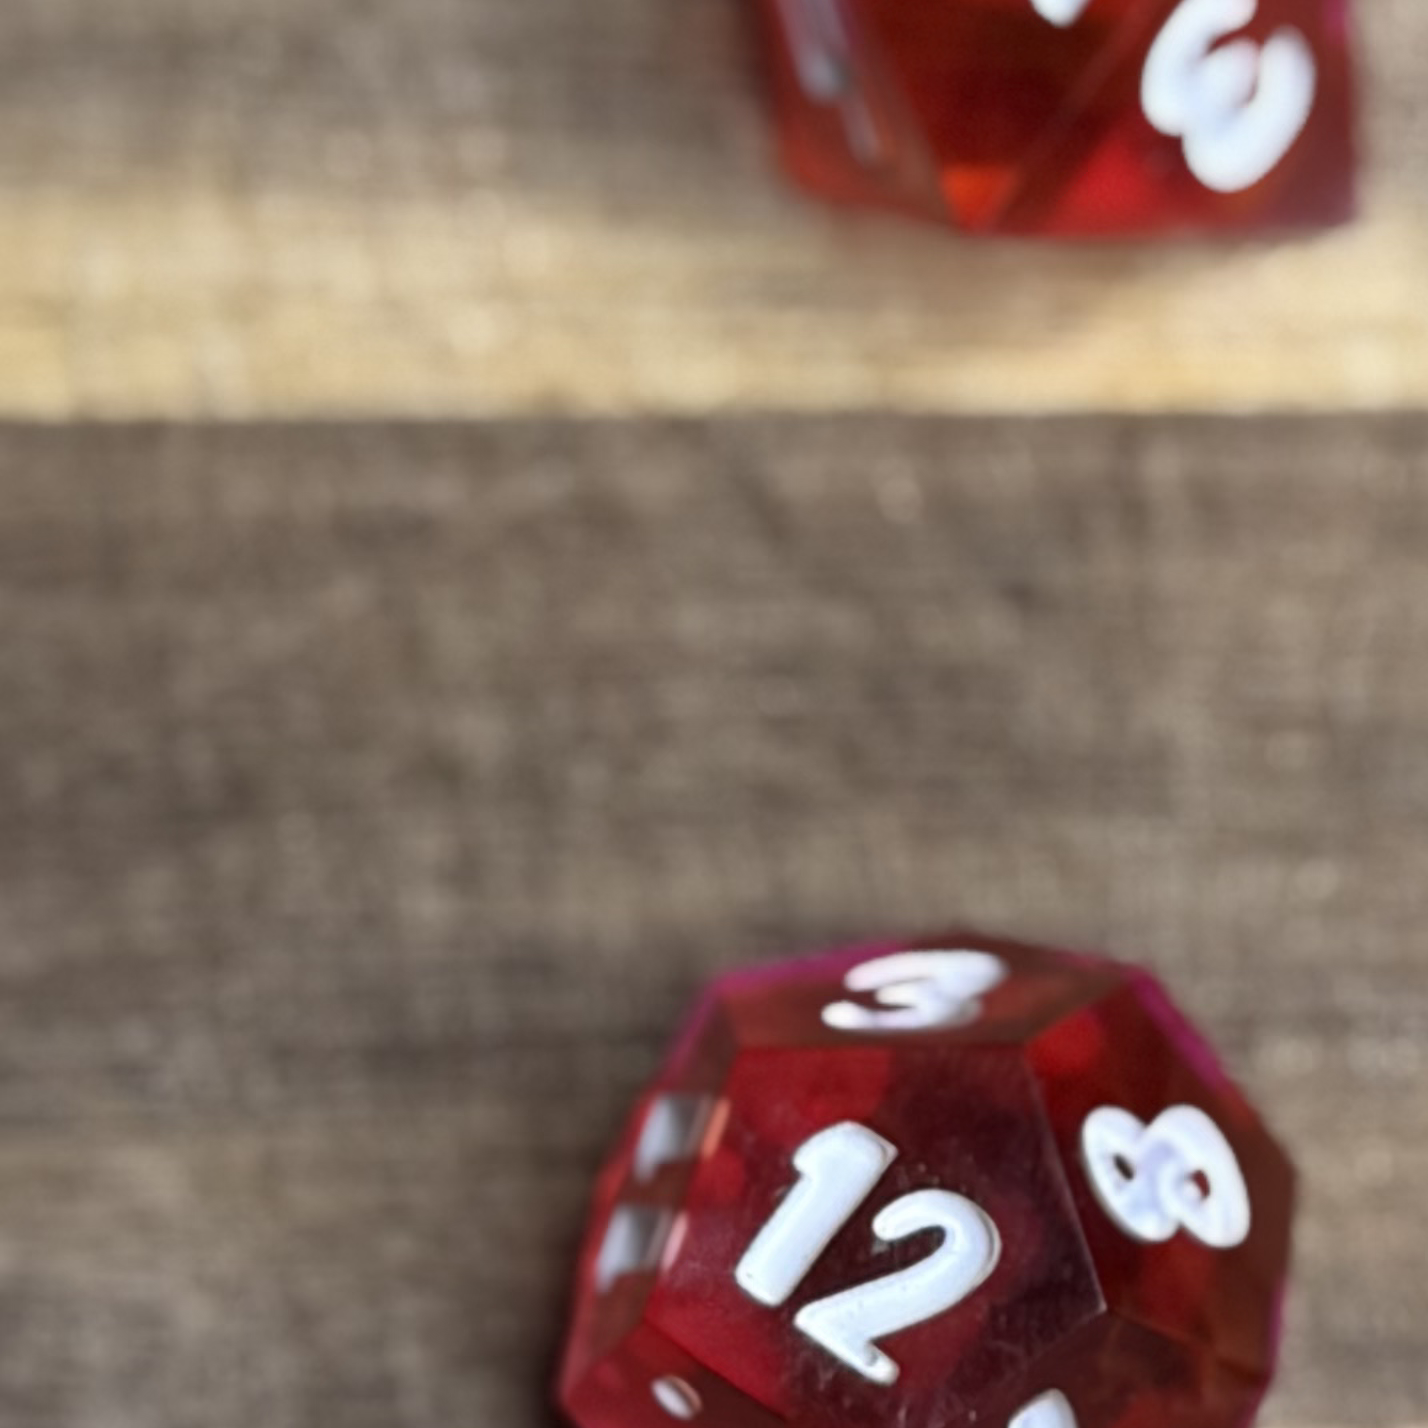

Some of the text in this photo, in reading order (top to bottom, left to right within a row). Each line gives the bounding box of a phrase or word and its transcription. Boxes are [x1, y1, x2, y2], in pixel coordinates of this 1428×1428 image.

[820, 949, 1008, 1029] 3
[1081, 1103, 1250, 1248] 8
[735, 1120, 1002, 1384] 12
